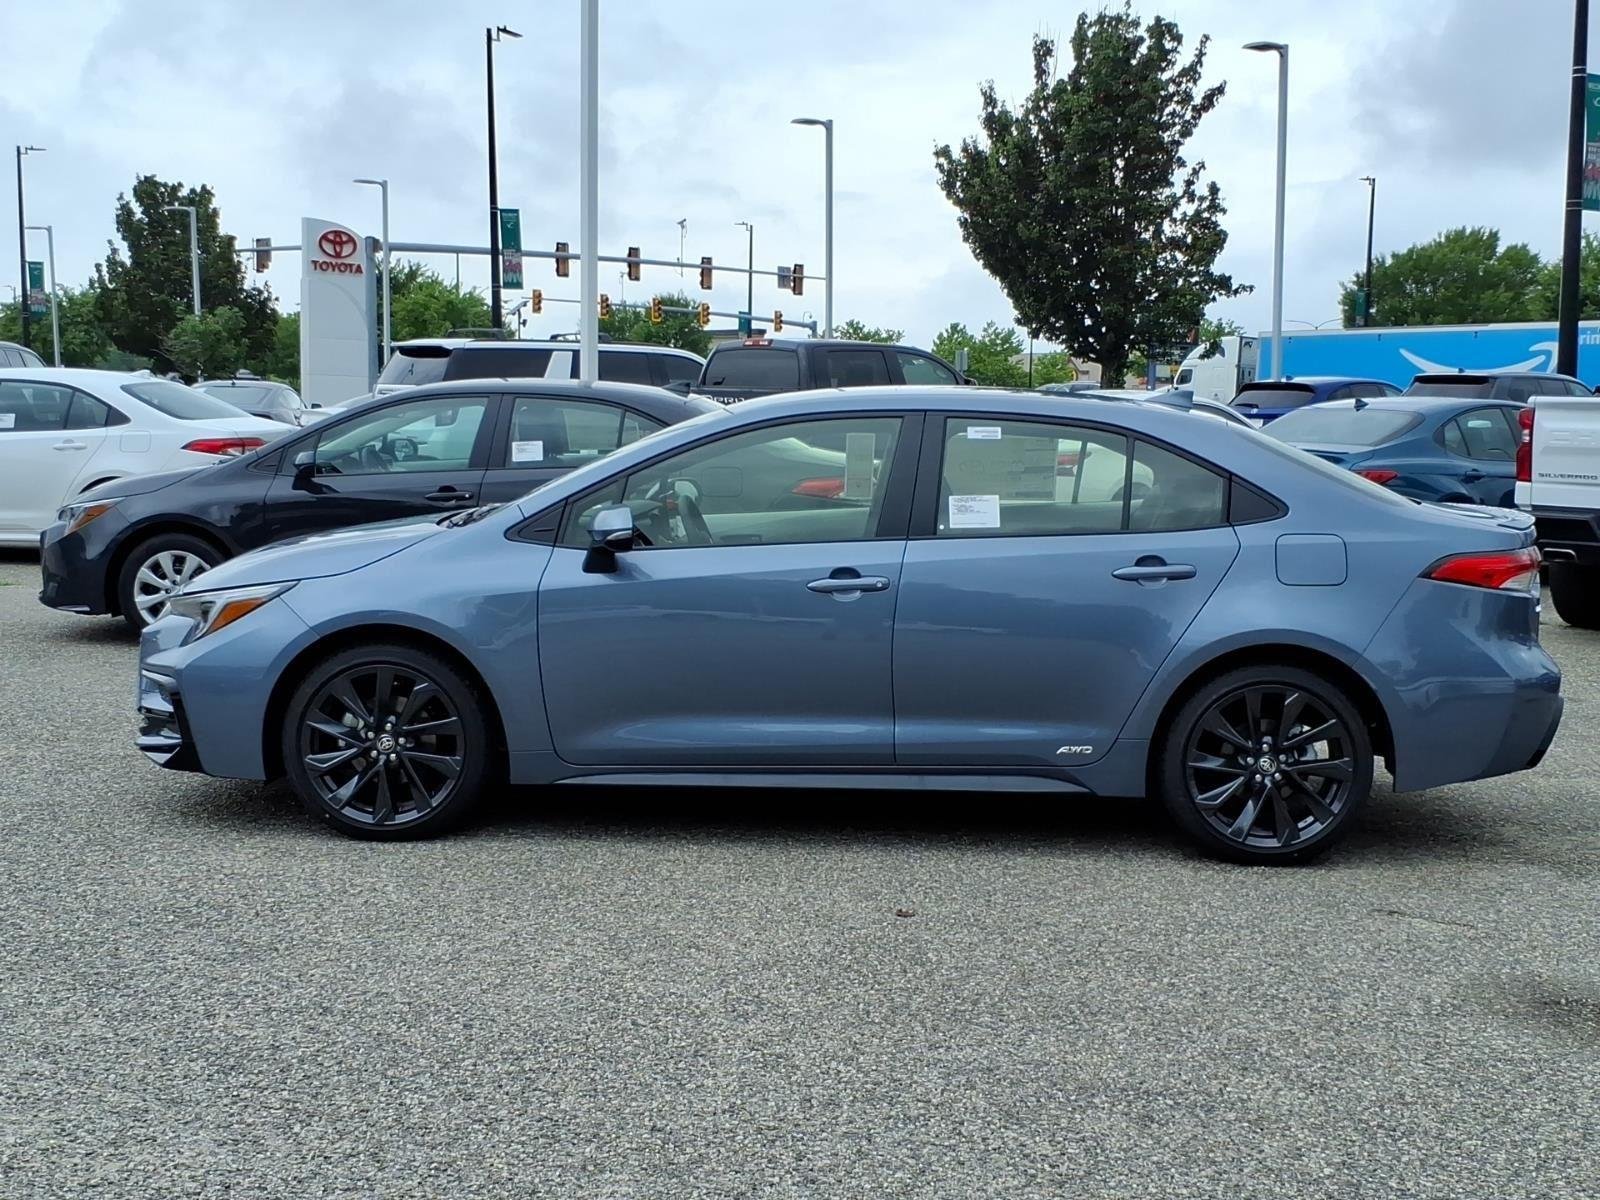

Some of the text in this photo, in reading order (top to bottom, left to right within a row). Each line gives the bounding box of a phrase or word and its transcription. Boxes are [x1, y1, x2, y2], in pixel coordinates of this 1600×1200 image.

[311, 260, 363, 274] TOYOTA
[1538, 472, 1598, 480] SILVERADO
[1056, 745, 1093, 754] AWD
